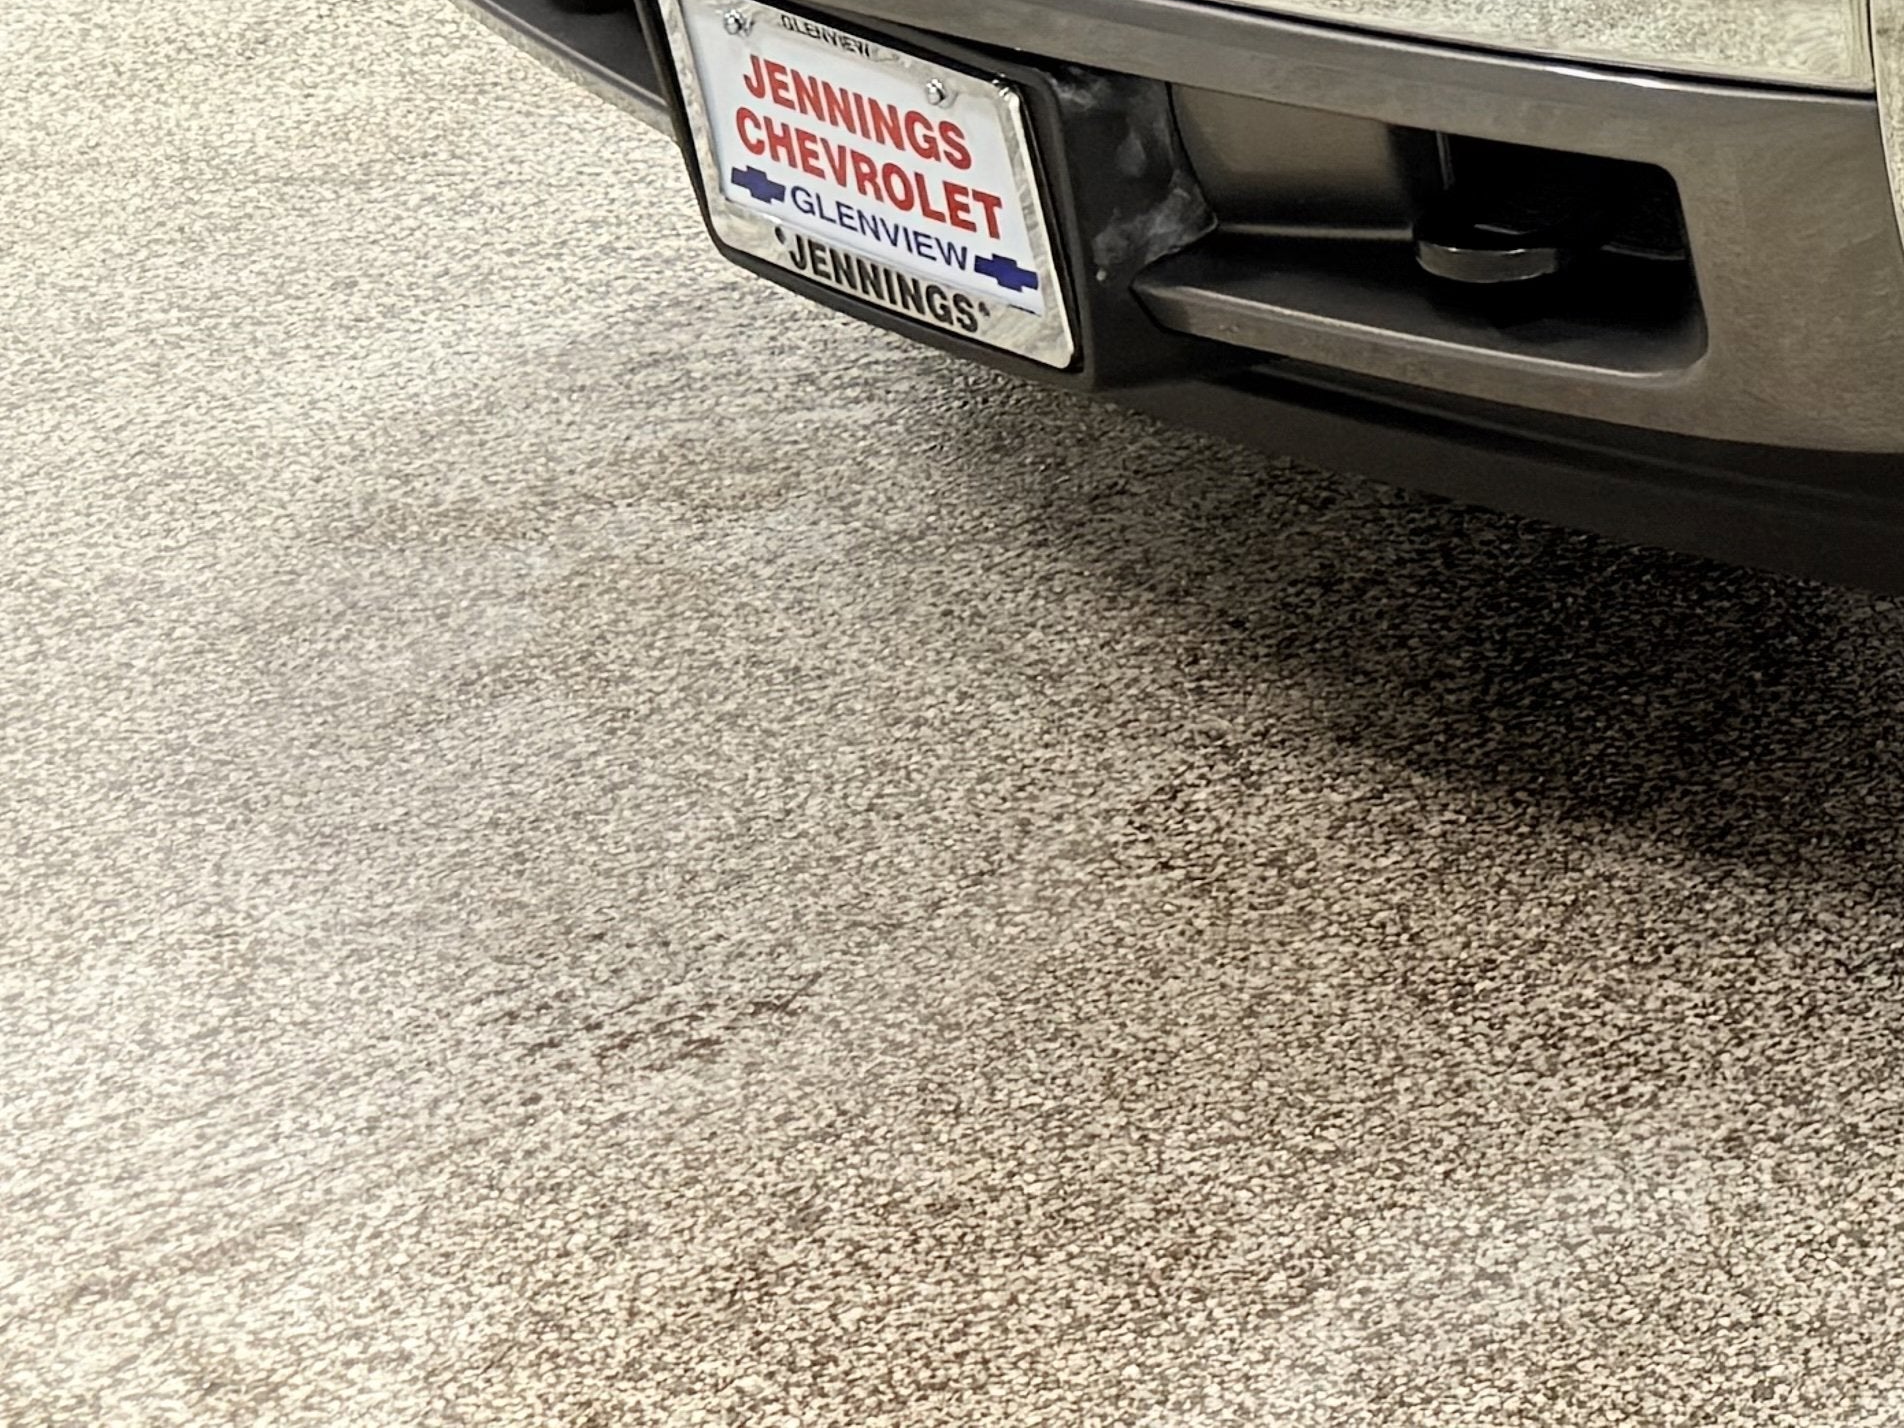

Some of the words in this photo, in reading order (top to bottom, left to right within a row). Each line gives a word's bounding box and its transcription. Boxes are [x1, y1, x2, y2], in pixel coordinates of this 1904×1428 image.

[743, 55, 972, 170] JENNINGS
[736, 107, 1003, 240] CHEVROLET
[790, 186, 969, 272] GLENVIEW
[789, 234, 979, 333] JENNINGS
